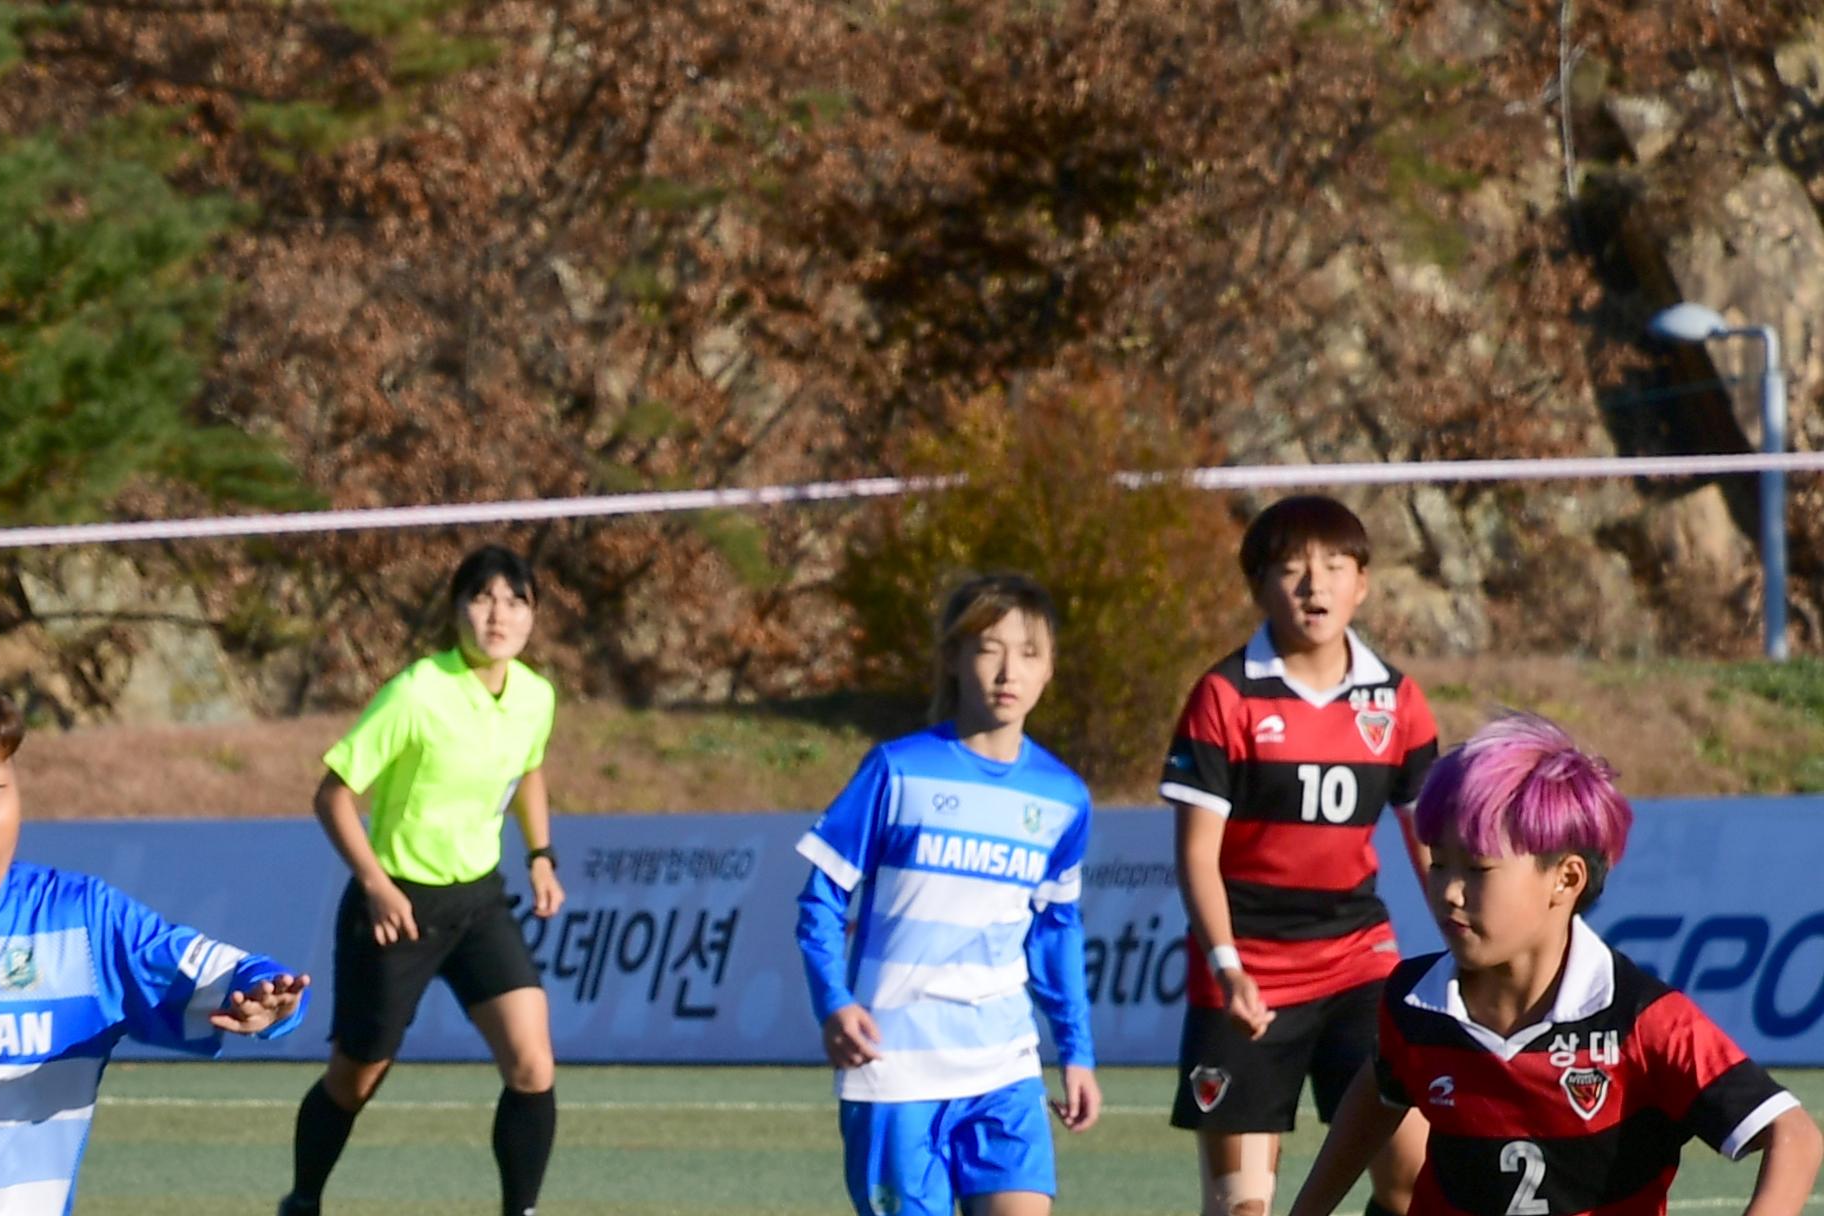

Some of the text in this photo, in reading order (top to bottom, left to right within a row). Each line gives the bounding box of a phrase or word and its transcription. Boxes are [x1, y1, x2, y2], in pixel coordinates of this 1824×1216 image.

[1298, 764, 1358, 823] 10
[915, 832, 1048, 884] NAMSAN
[1548, 1030, 1620, 1067] 상대
[1500, 1140, 1549, 1216] 2
